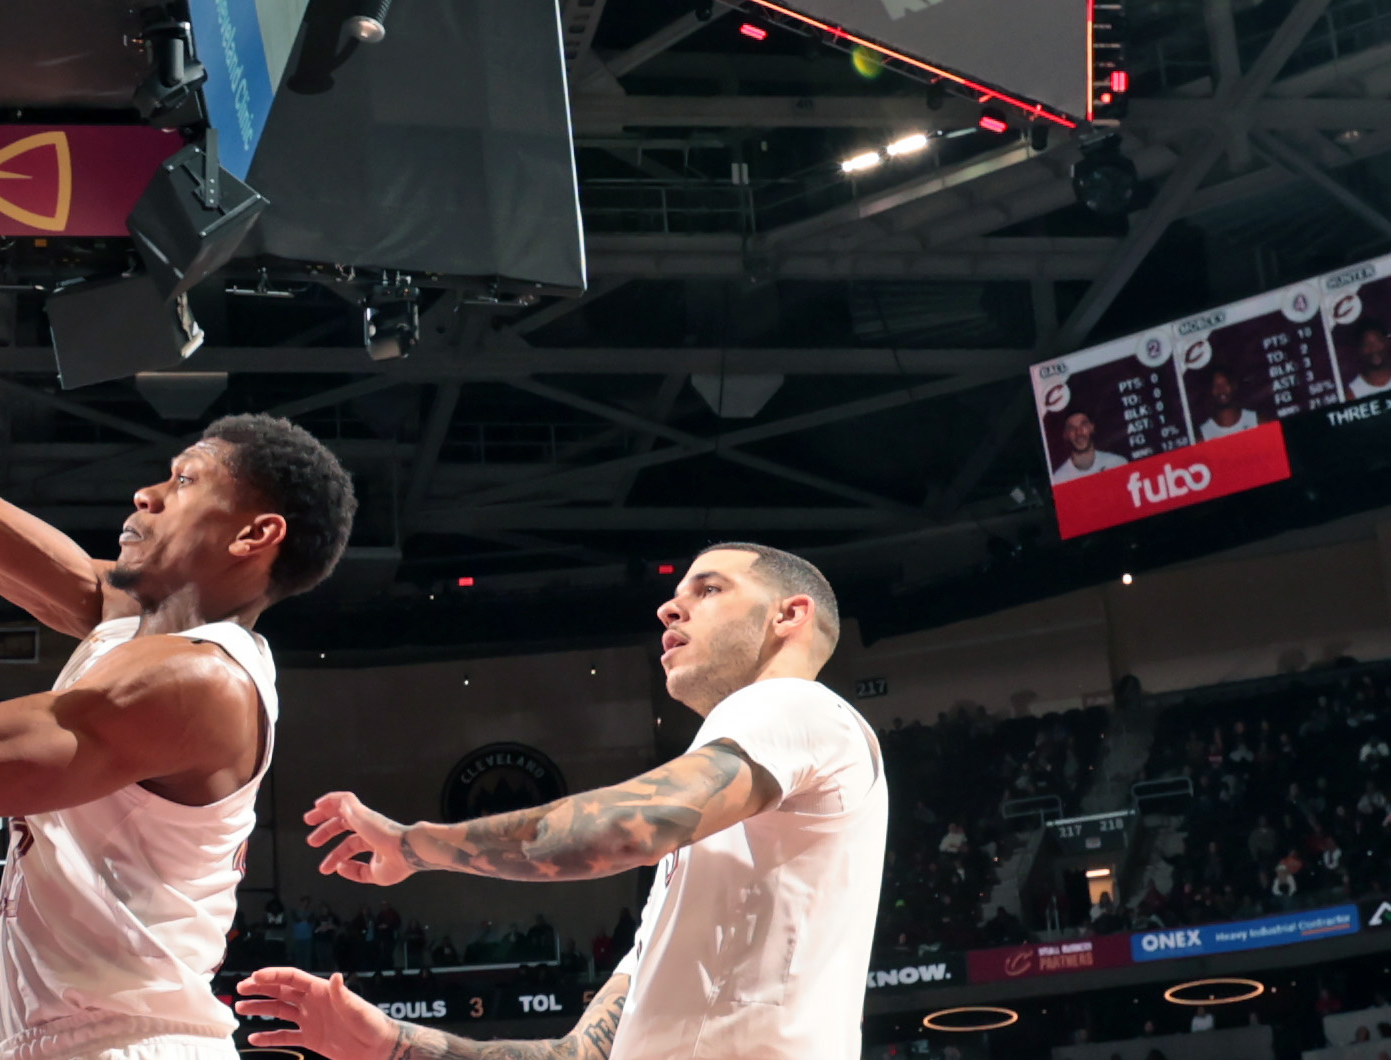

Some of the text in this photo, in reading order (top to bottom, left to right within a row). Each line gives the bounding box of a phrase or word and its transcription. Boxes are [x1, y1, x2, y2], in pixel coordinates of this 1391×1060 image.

[1145, 339, 1162, 359] 2
[1326, 400, 1381, 427] THREE
[1127, 463, 1212, 507] fubo
[857, 680, 886, 697] 217
[460, 752, 546, 786] CLEVELAND
[1058, 824, 1083, 839] 217
[1141, 928, 1202, 952] ONEX
[469, 998, 484, 1018] 3
[518, 994, 563, 1012] TOL
